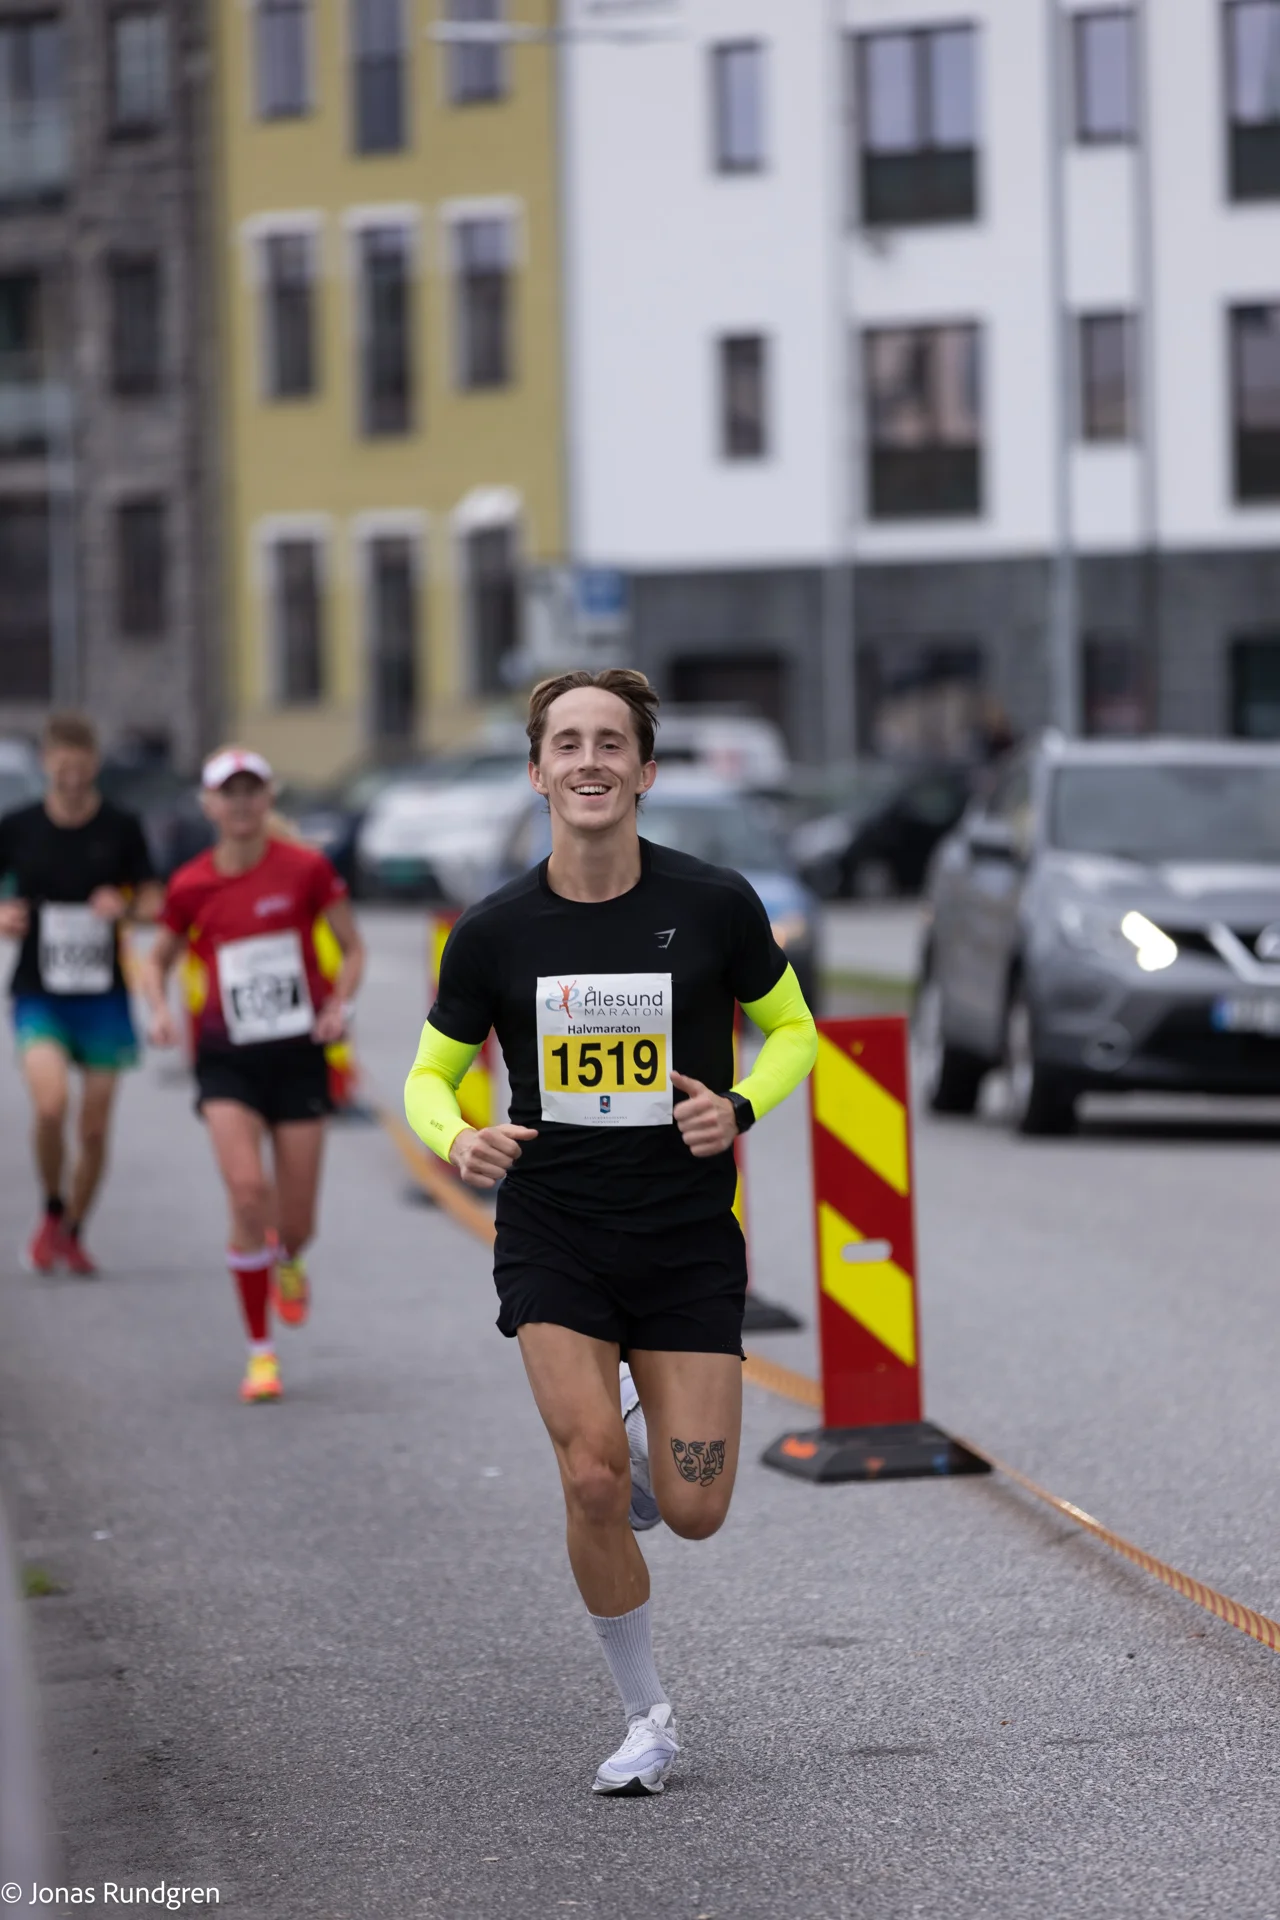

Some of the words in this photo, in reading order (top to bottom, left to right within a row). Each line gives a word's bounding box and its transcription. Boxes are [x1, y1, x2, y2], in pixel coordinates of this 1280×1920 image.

[585, 986, 663, 1007] Ålesund
[584, 1008, 663, 1017] MARATON
[567, 1024, 641, 1035] Halvmaraton
[552, 1039, 659, 1088] 1519
